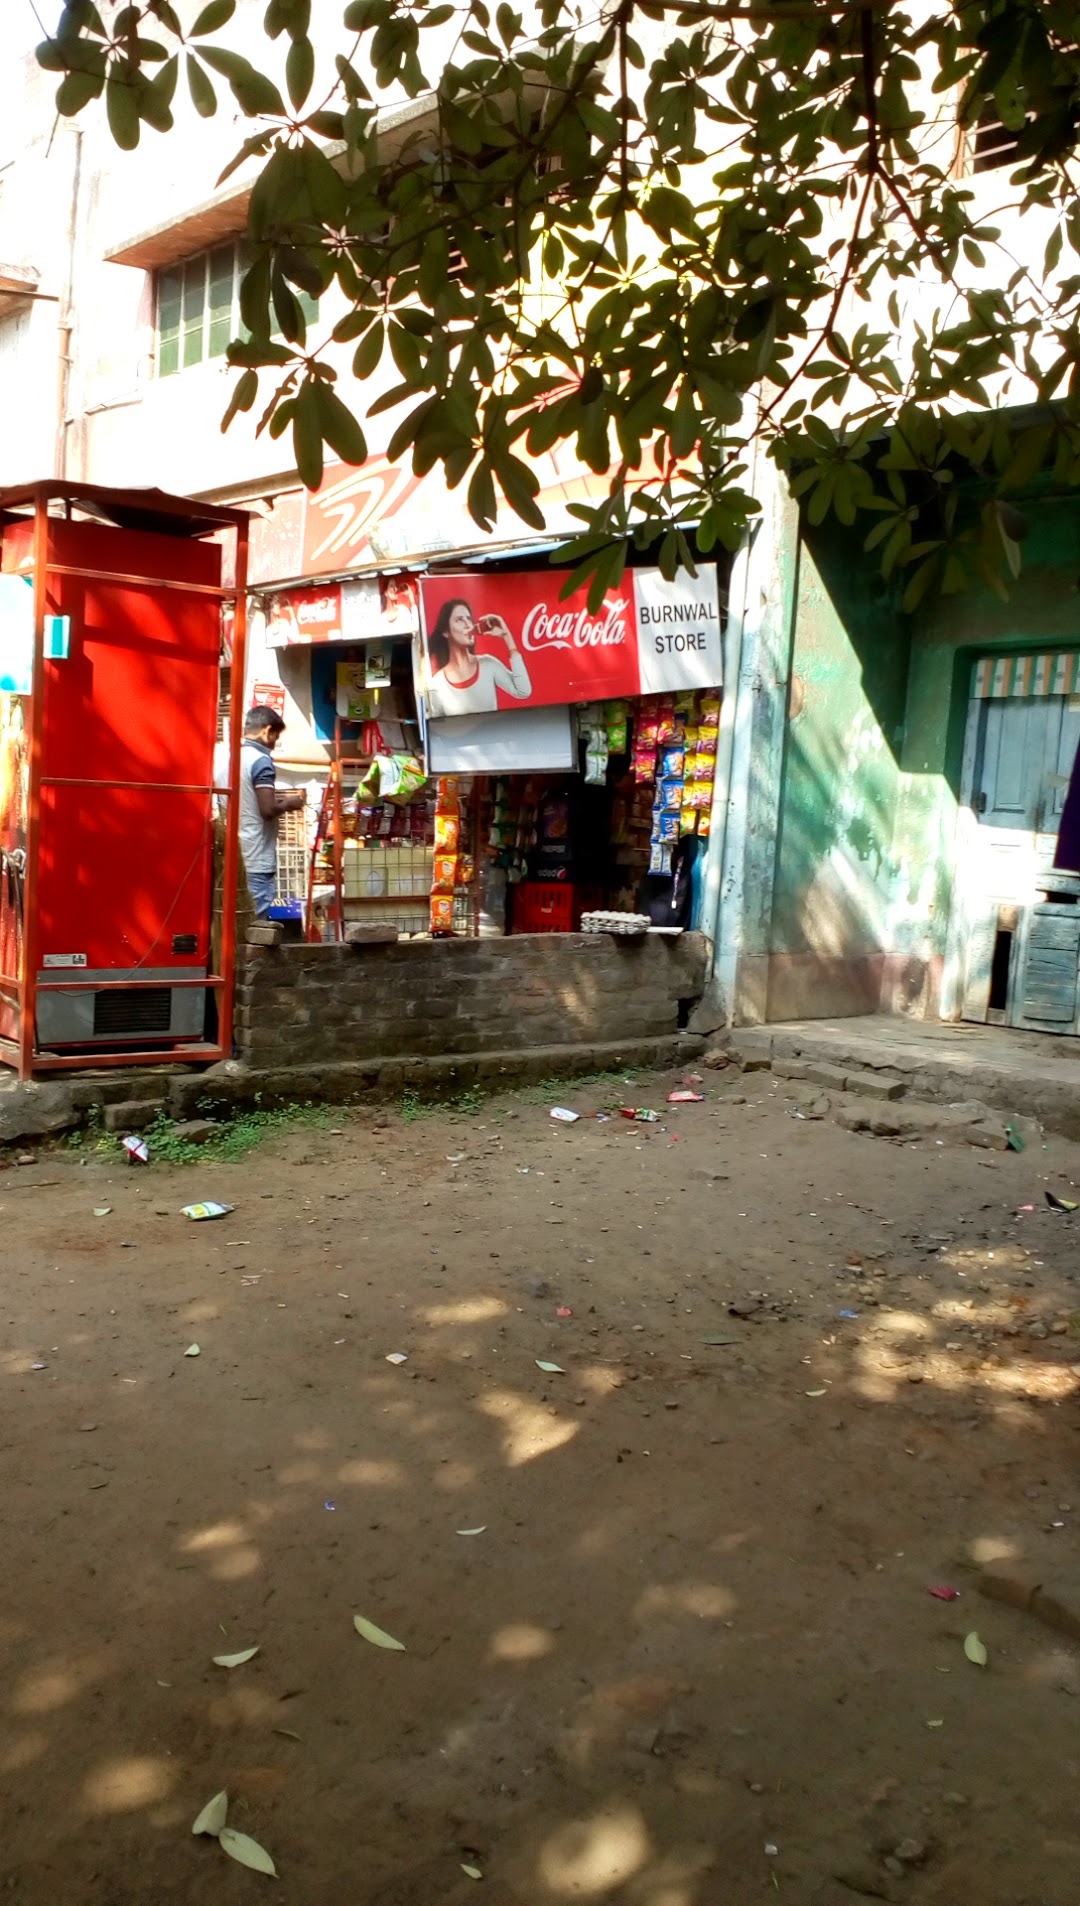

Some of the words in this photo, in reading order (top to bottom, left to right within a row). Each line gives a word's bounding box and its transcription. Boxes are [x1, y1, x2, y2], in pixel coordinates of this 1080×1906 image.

[522, 599, 630, 651] Coca-Cola
[640, 602, 717, 625] BURNWAL
[655, 633, 706, 654] STORE
